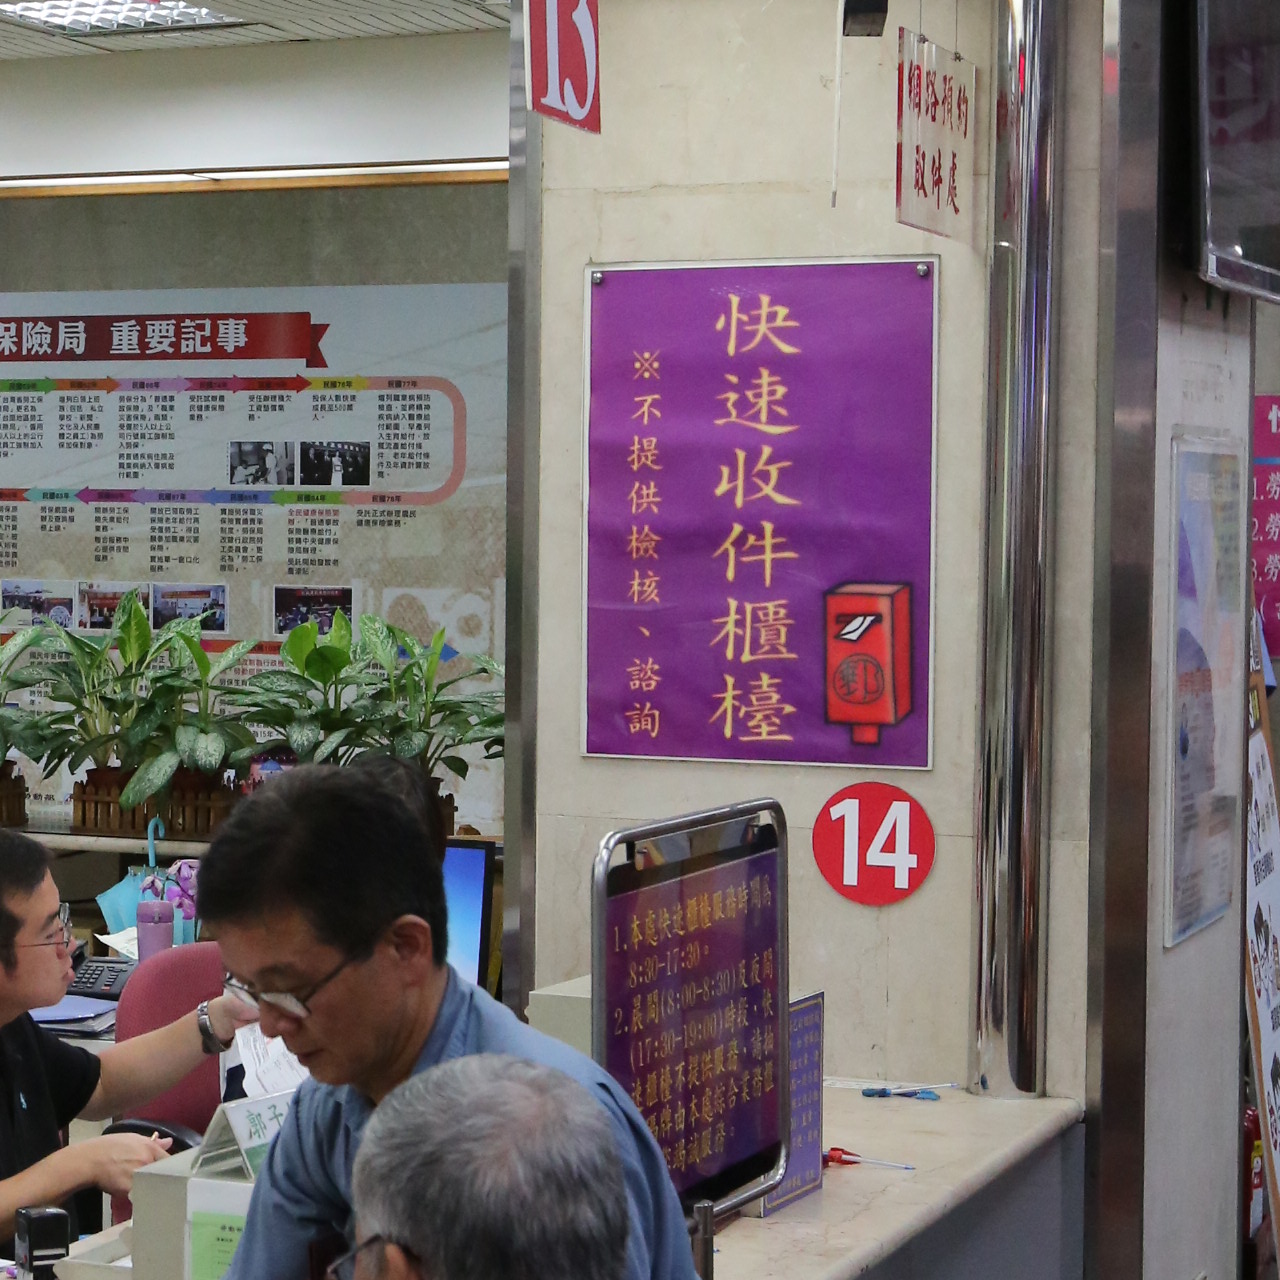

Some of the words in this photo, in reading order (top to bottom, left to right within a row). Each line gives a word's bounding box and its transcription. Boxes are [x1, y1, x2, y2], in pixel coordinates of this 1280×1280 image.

[908, 59, 968, 139] 網路預約
[914, 144, 959, 215] 取件處
[109, 319, 250, 355] 重要記事
[708, 293, 803, 742] 快速收件櫃檯
[828, 798, 918, 889] 14
